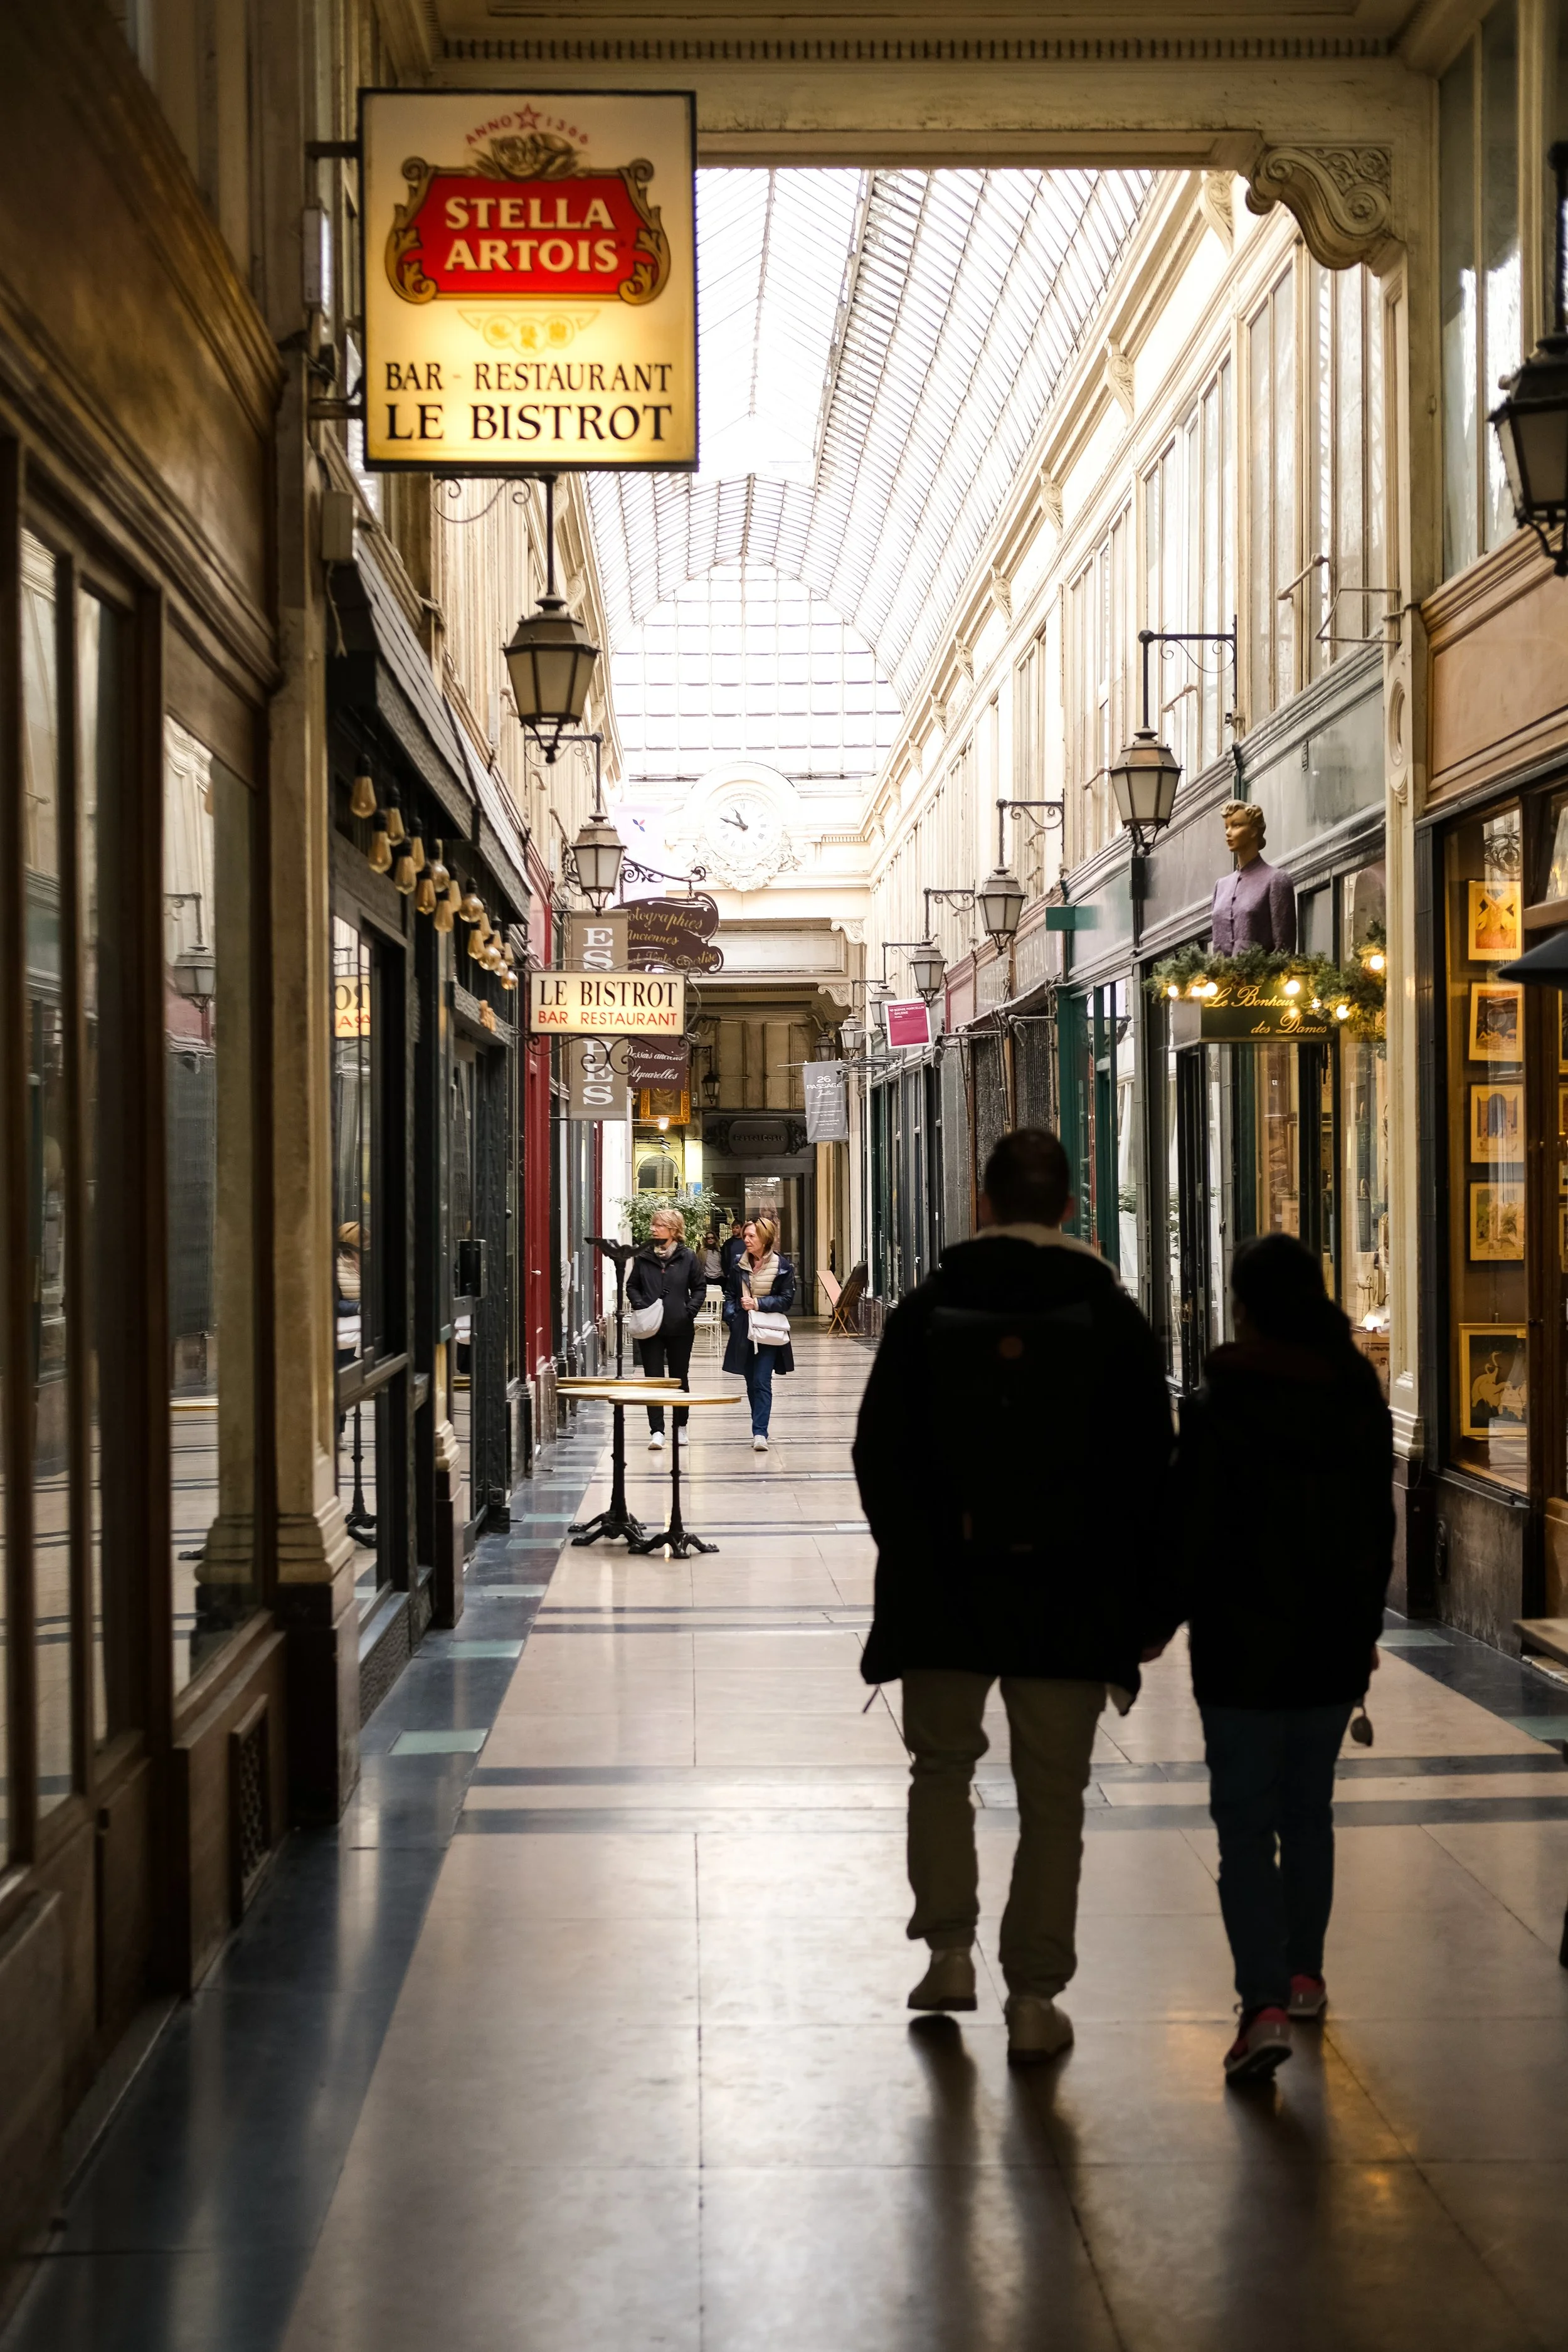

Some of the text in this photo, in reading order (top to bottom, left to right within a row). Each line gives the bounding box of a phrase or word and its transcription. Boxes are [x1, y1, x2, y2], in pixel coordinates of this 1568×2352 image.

[465, 115, 512, 145] ANNO
[445, 196, 616, 230] STELLA
[443, 238, 620, 273] ARTOIS
[384, 361, 444, 392] BAR
[474, 363, 673, 393] RESTAURANT
[386, 403, 674, 442] LE BISTROT
[627, 907, 702, 931] otographies
[540, 980, 677, 1007] LE BISTROT
[1204, 985, 1295, 1008] Le Bonheur
[538, 1010, 677, 1026] BAR RESTAURANT
[1251, 1014, 1327, 1034] des Dames
[629, 1066, 679, 1083] Aquarelles
